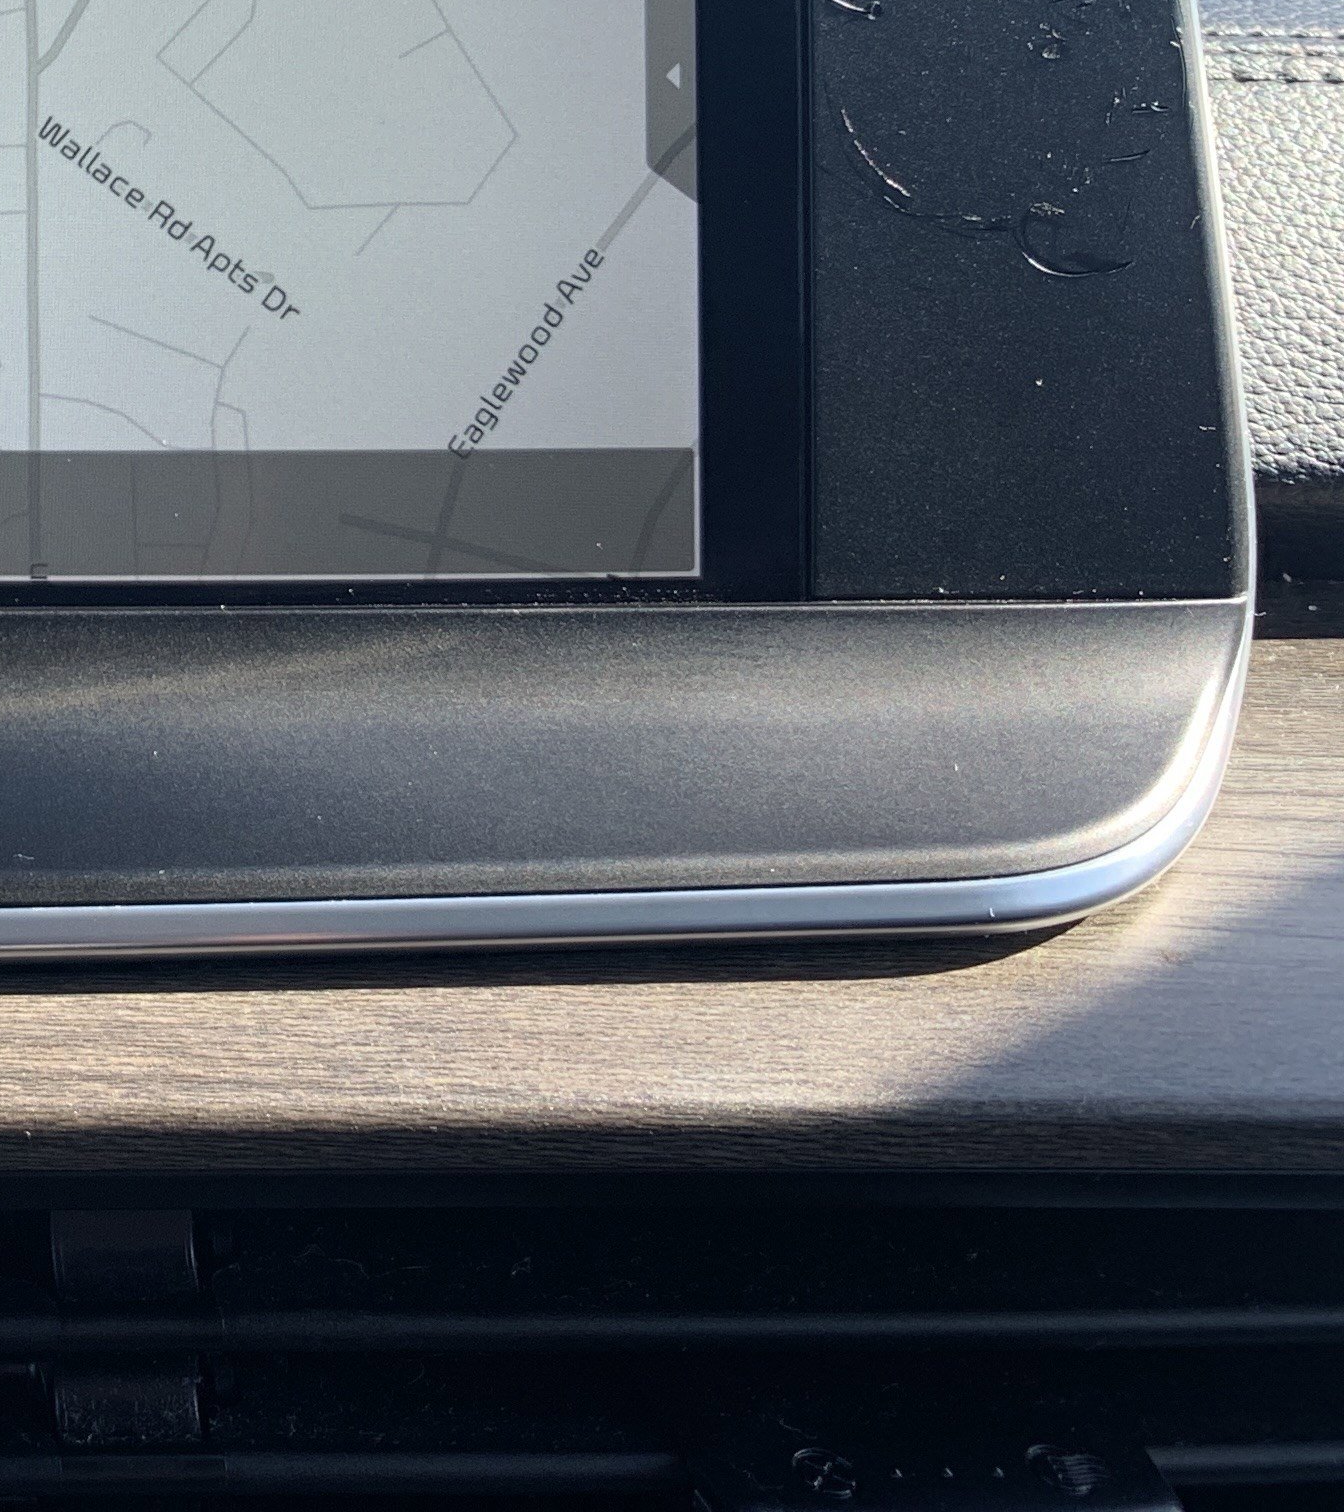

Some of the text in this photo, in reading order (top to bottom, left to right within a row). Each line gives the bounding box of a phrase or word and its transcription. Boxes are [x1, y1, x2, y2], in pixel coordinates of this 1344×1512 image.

[38, 115, 302, 321] Wallace Rd Apts Dr
[447, 245, 606, 460] Eaglewood Ave
